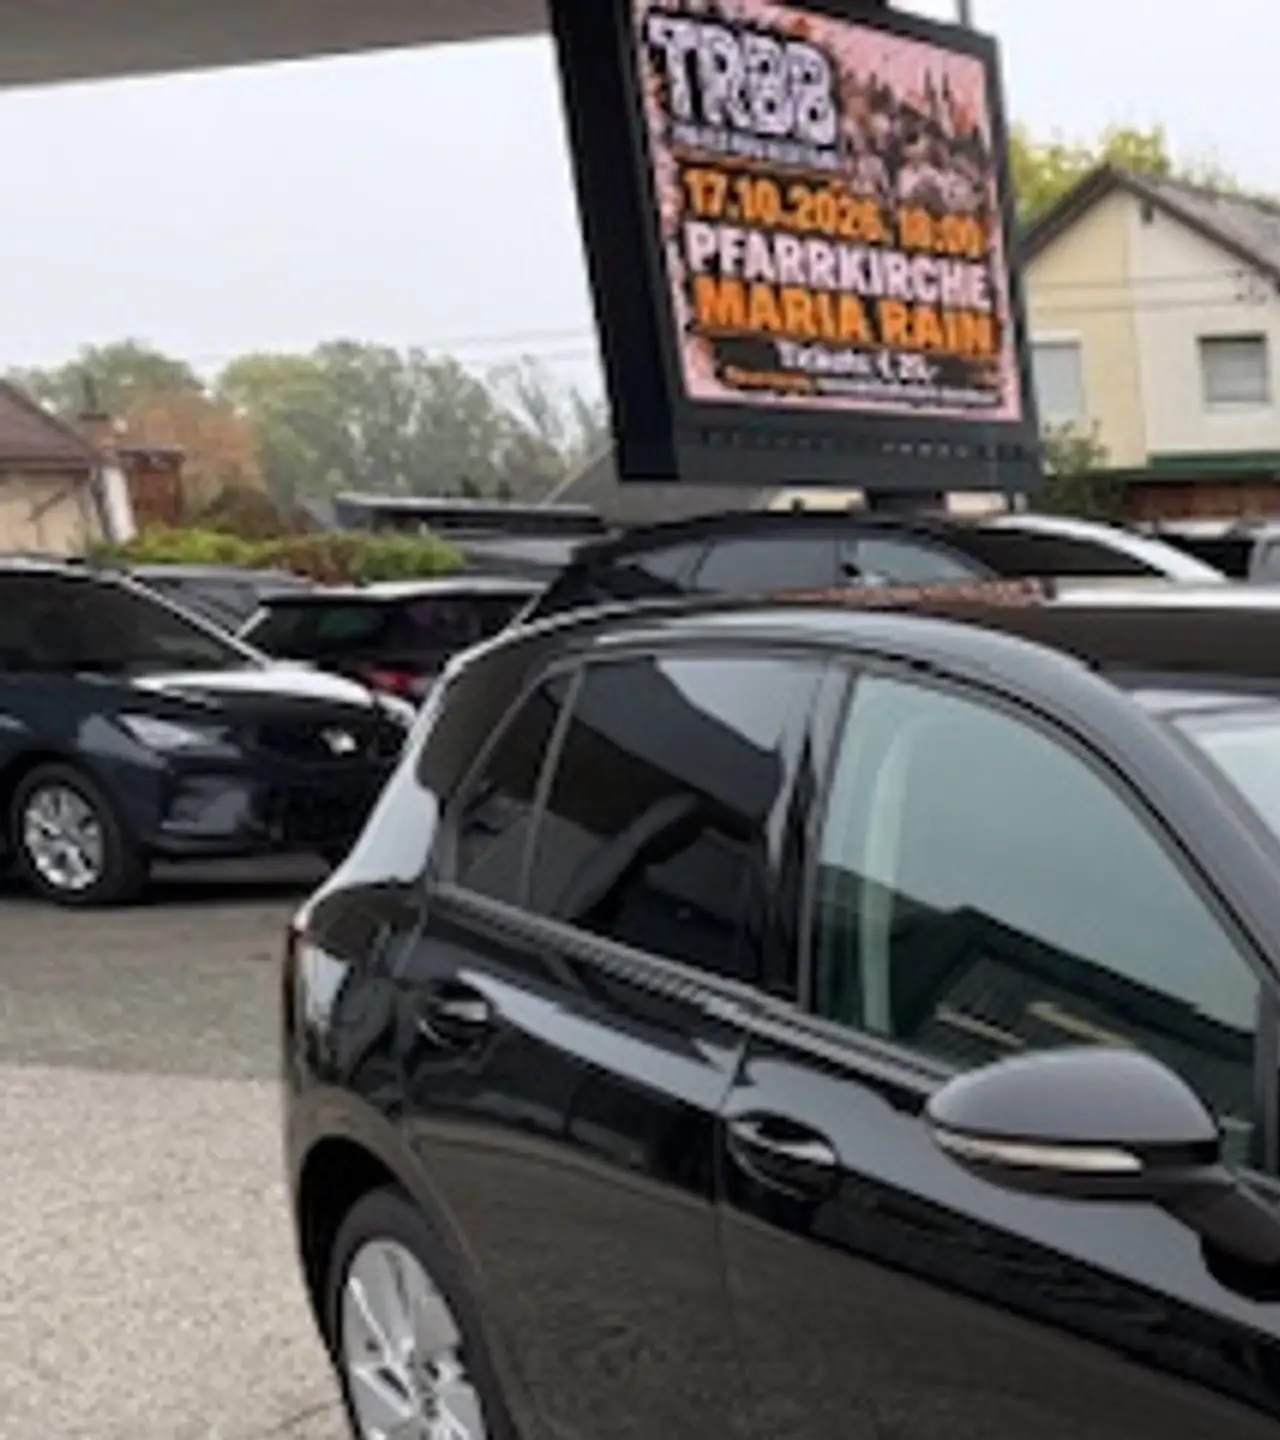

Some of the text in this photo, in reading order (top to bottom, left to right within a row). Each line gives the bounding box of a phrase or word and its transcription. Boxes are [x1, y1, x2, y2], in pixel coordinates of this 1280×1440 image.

[684, 220, 991, 309] PFARRKIRCHE
[693, 276, 993, 355] MARIA RAIN
